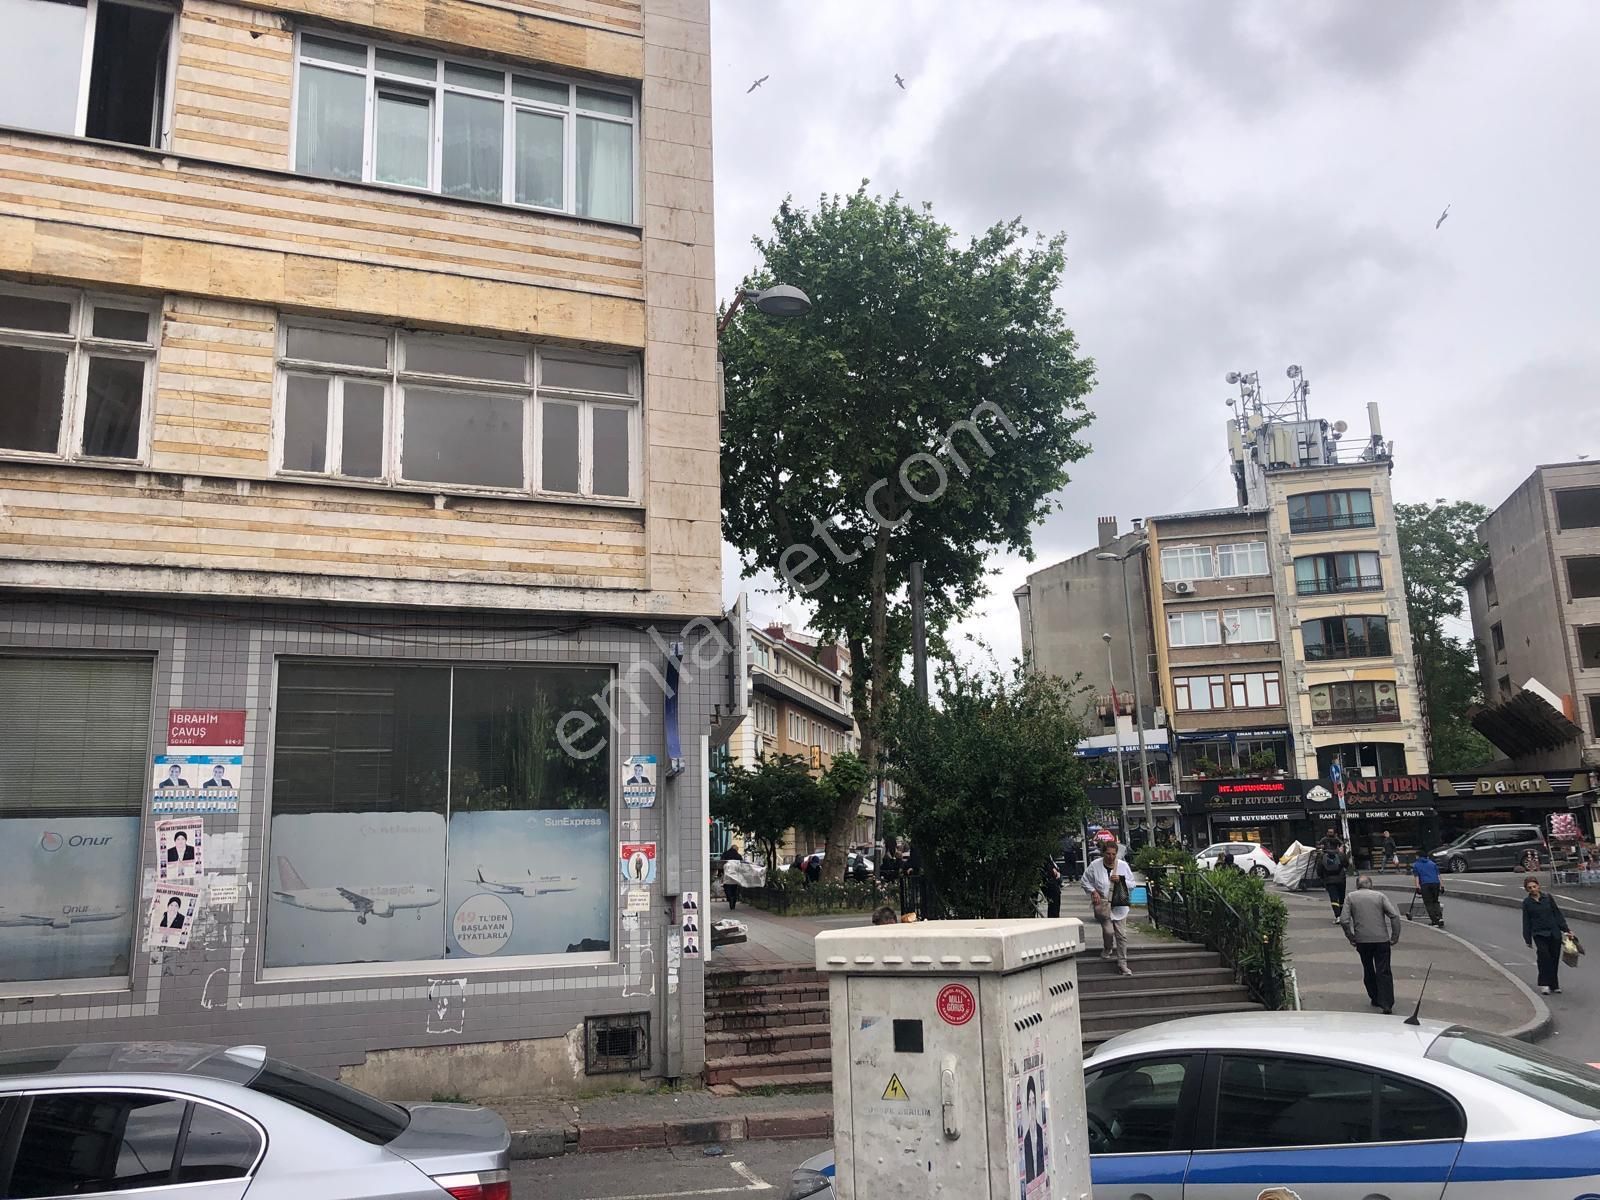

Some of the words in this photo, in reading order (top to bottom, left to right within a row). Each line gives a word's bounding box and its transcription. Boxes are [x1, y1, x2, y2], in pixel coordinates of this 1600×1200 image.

[173, 713, 218, 724] İBRAHİM
[171, 727, 207, 738] ÇAVUŞ
[1481, 778, 1542, 793] DAMAT
[1133, 790, 1172, 802] BLIK
[1232, 797, 1244, 805] HT
[1246, 795, 1302, 804] KUYUMCULUK
[544, 817, 602, 828] SunExpress
[68, 835, 112, 847] Onur
[456, 911, 476, 924] 49
[461, 924, 505, 933] BAŞLAYAN
[457, 932, 508, 941] FİYATLARLA
